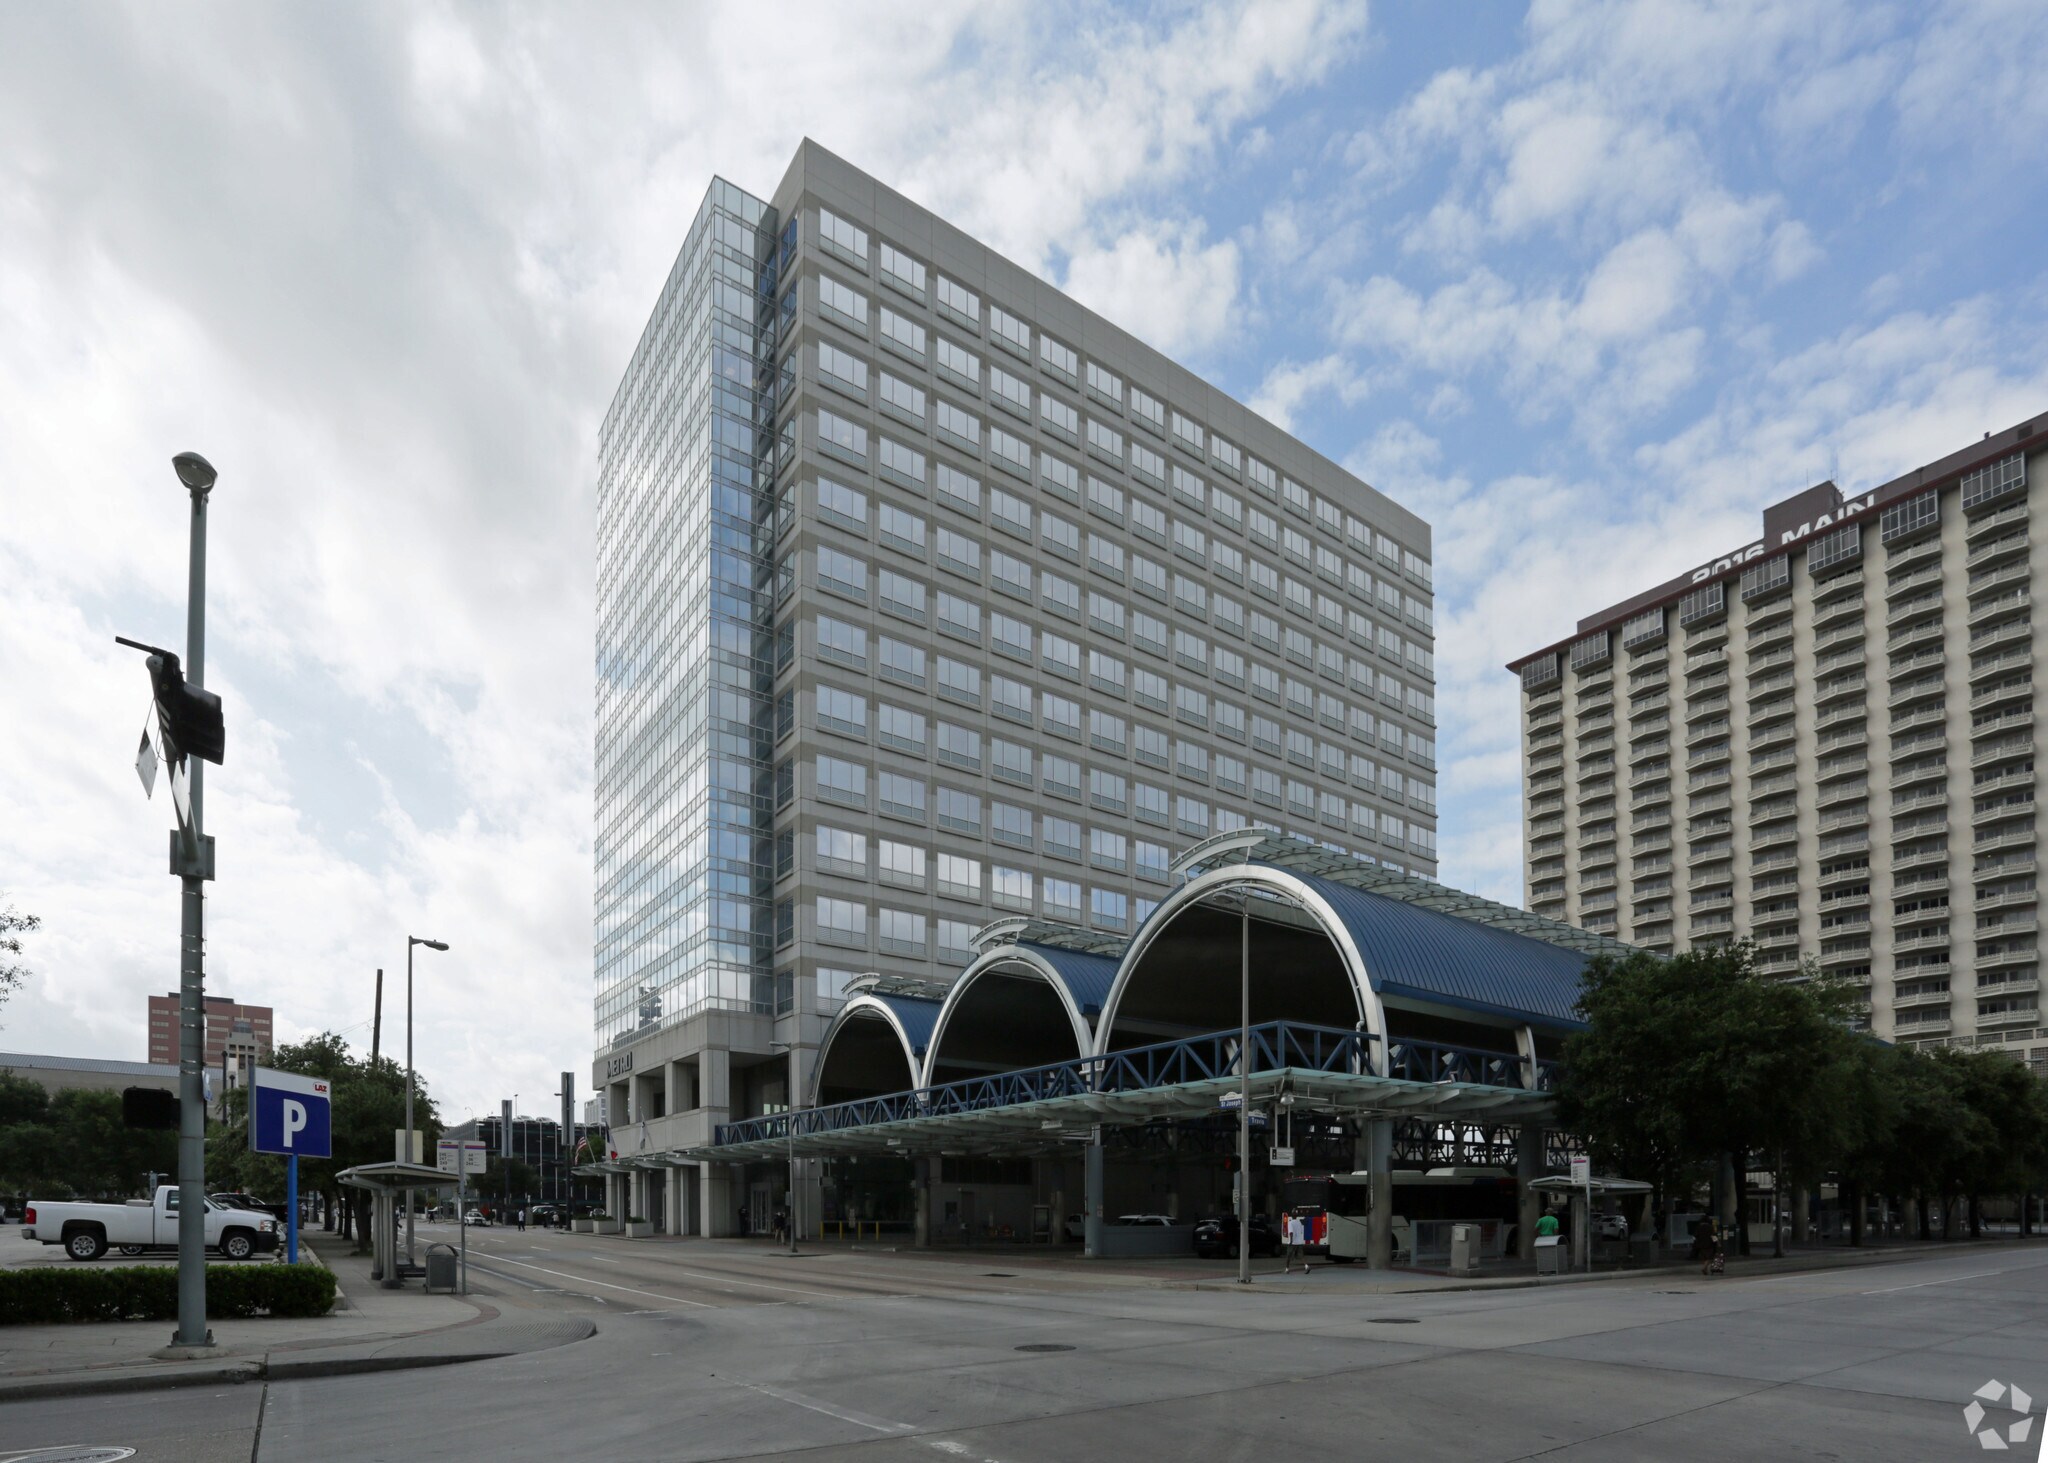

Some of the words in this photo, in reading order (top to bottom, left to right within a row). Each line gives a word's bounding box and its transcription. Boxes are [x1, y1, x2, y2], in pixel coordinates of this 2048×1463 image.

[1692, 543, 1765, 583] 2016
[1781, 494, 1875, 545] MAIN
[314, 1084, 328, 1092] LAZ
[283, 1098, 307, 1148] P
